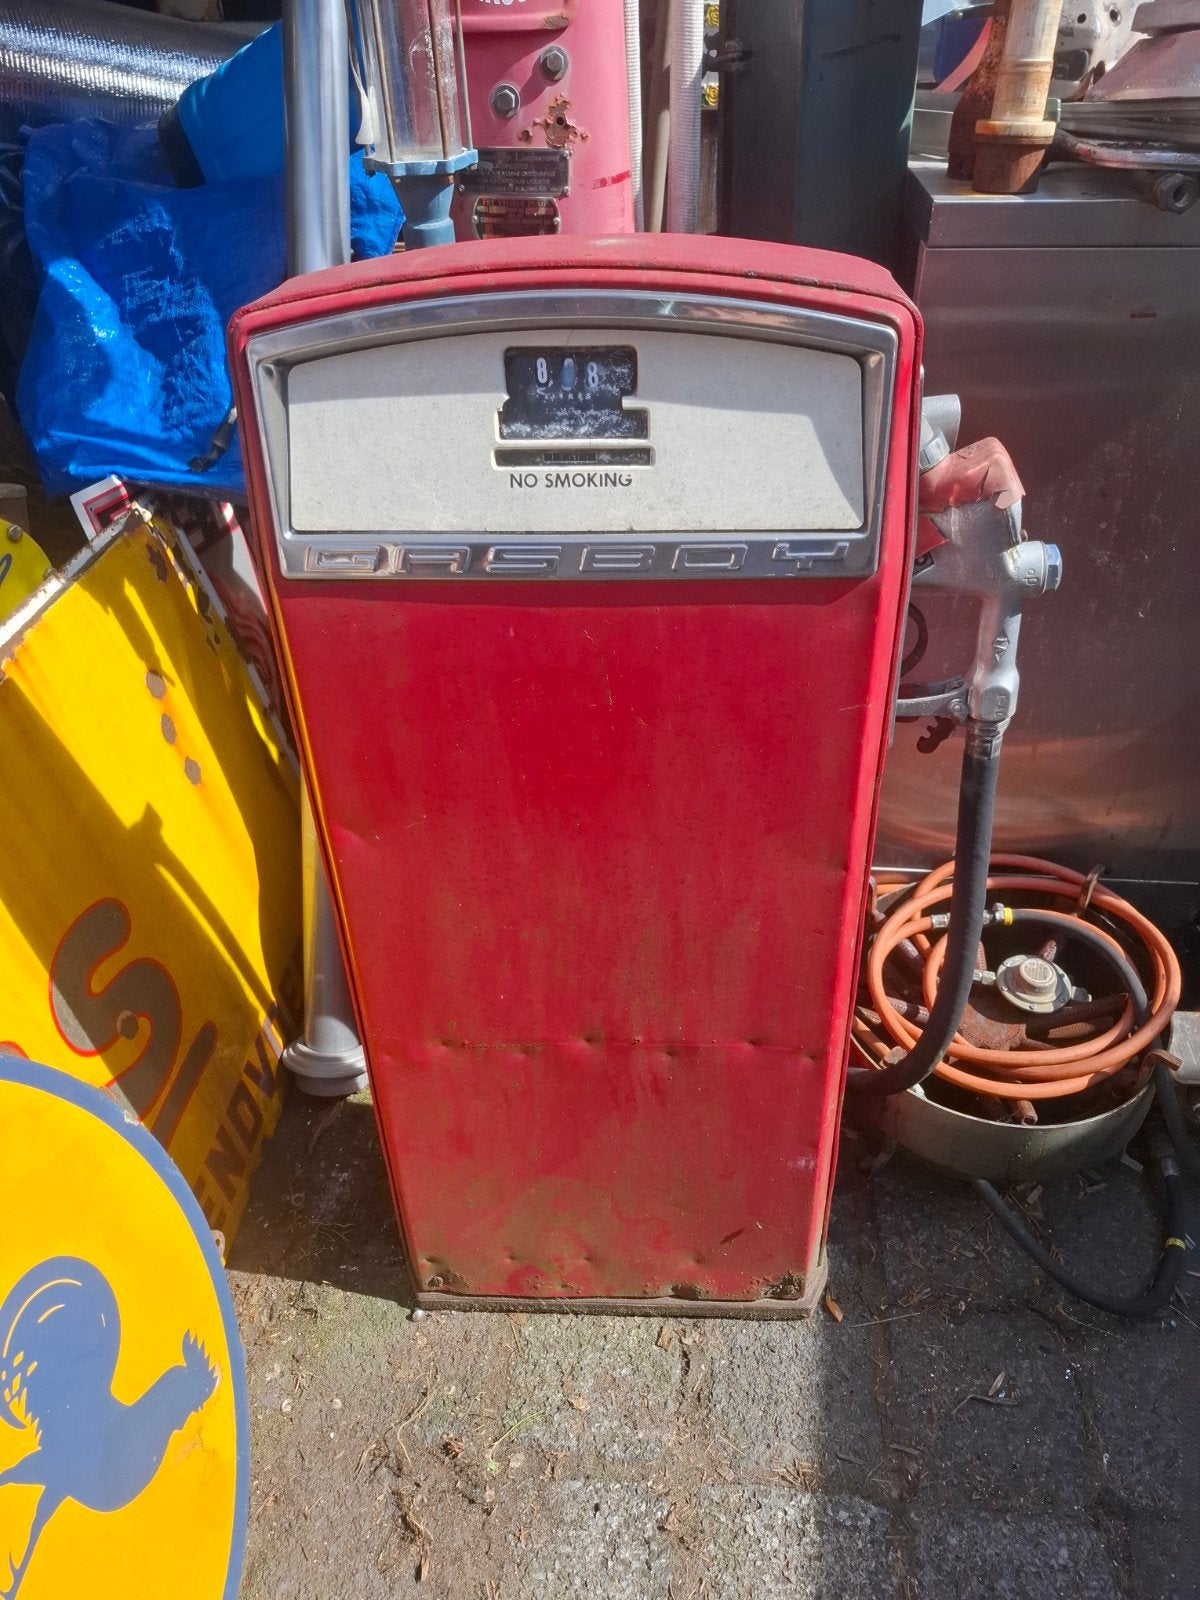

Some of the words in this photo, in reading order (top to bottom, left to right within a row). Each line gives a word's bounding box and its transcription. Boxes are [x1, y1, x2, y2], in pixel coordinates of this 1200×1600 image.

[510, 473, 538, 489] NO
[545, 472, 633, 488] SMOKING
[305, 541, 848, 574] GASBOY
